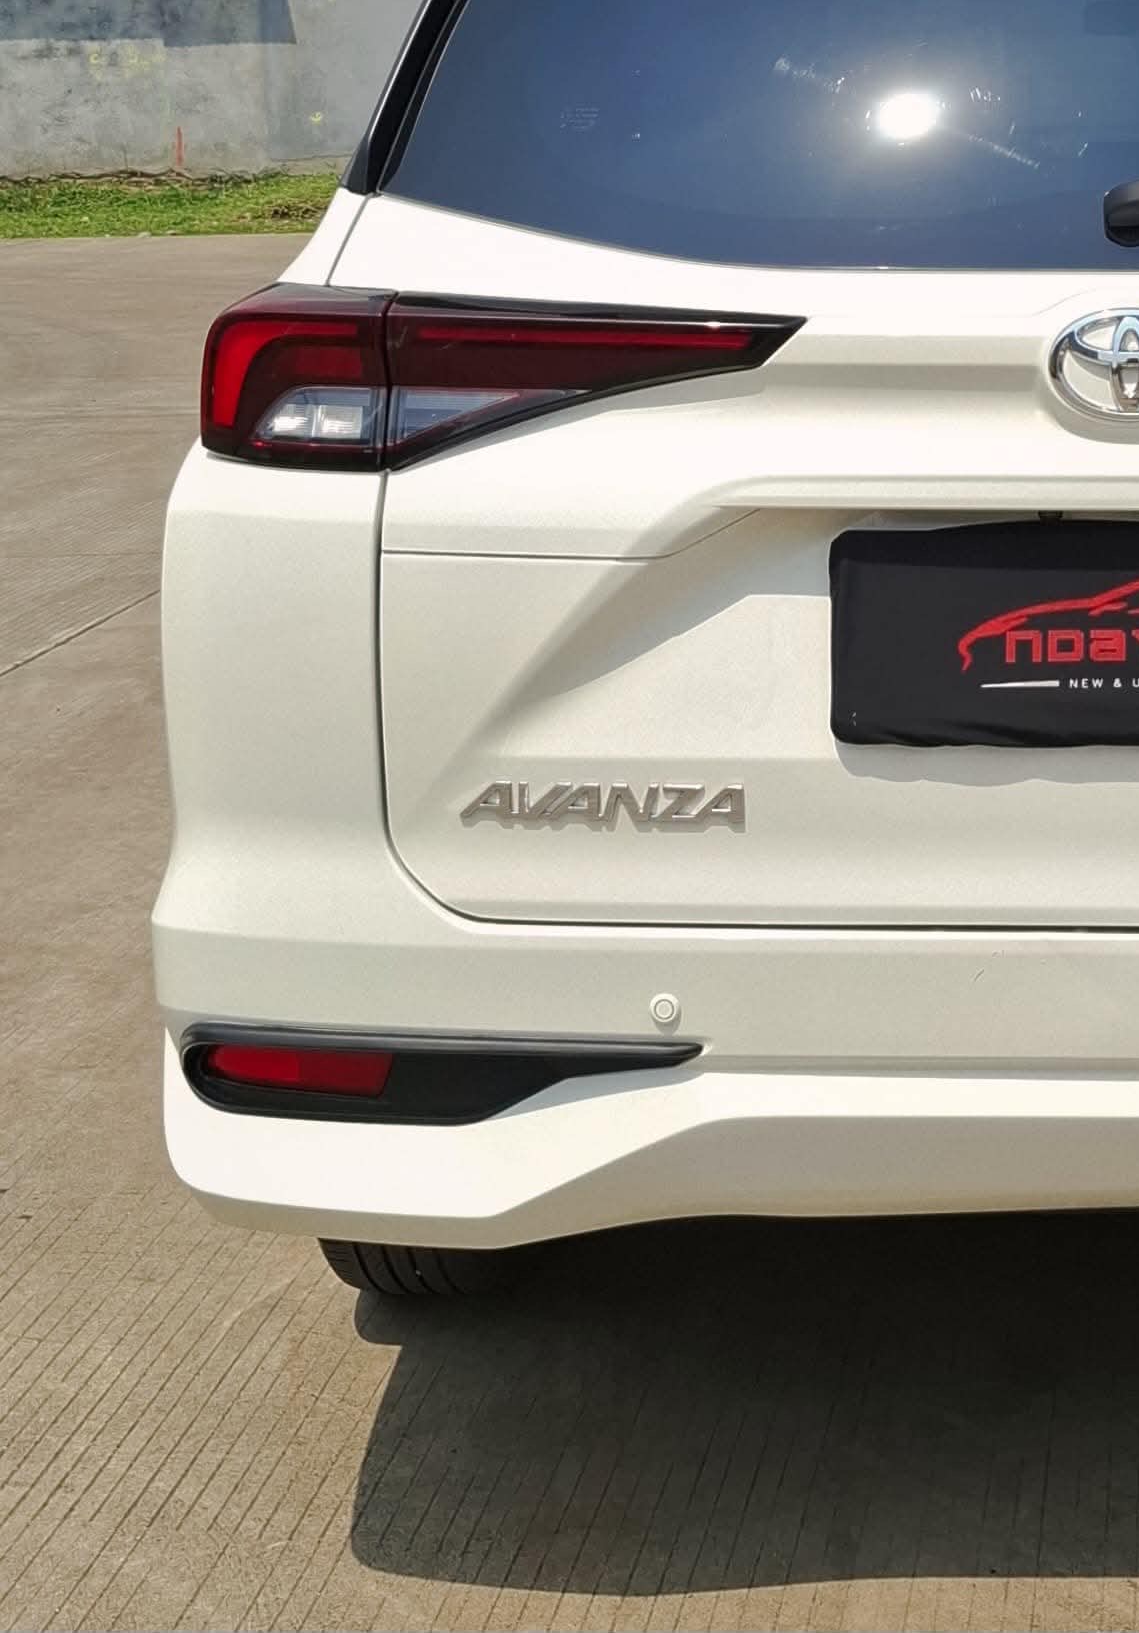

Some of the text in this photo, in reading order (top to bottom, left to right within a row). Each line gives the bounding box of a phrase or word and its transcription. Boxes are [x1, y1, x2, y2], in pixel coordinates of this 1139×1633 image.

[1069, 678, 1104, 689] NEW
[1113, 678, 1122, 688] &
[460, 780, 746, 830] AVANZA
